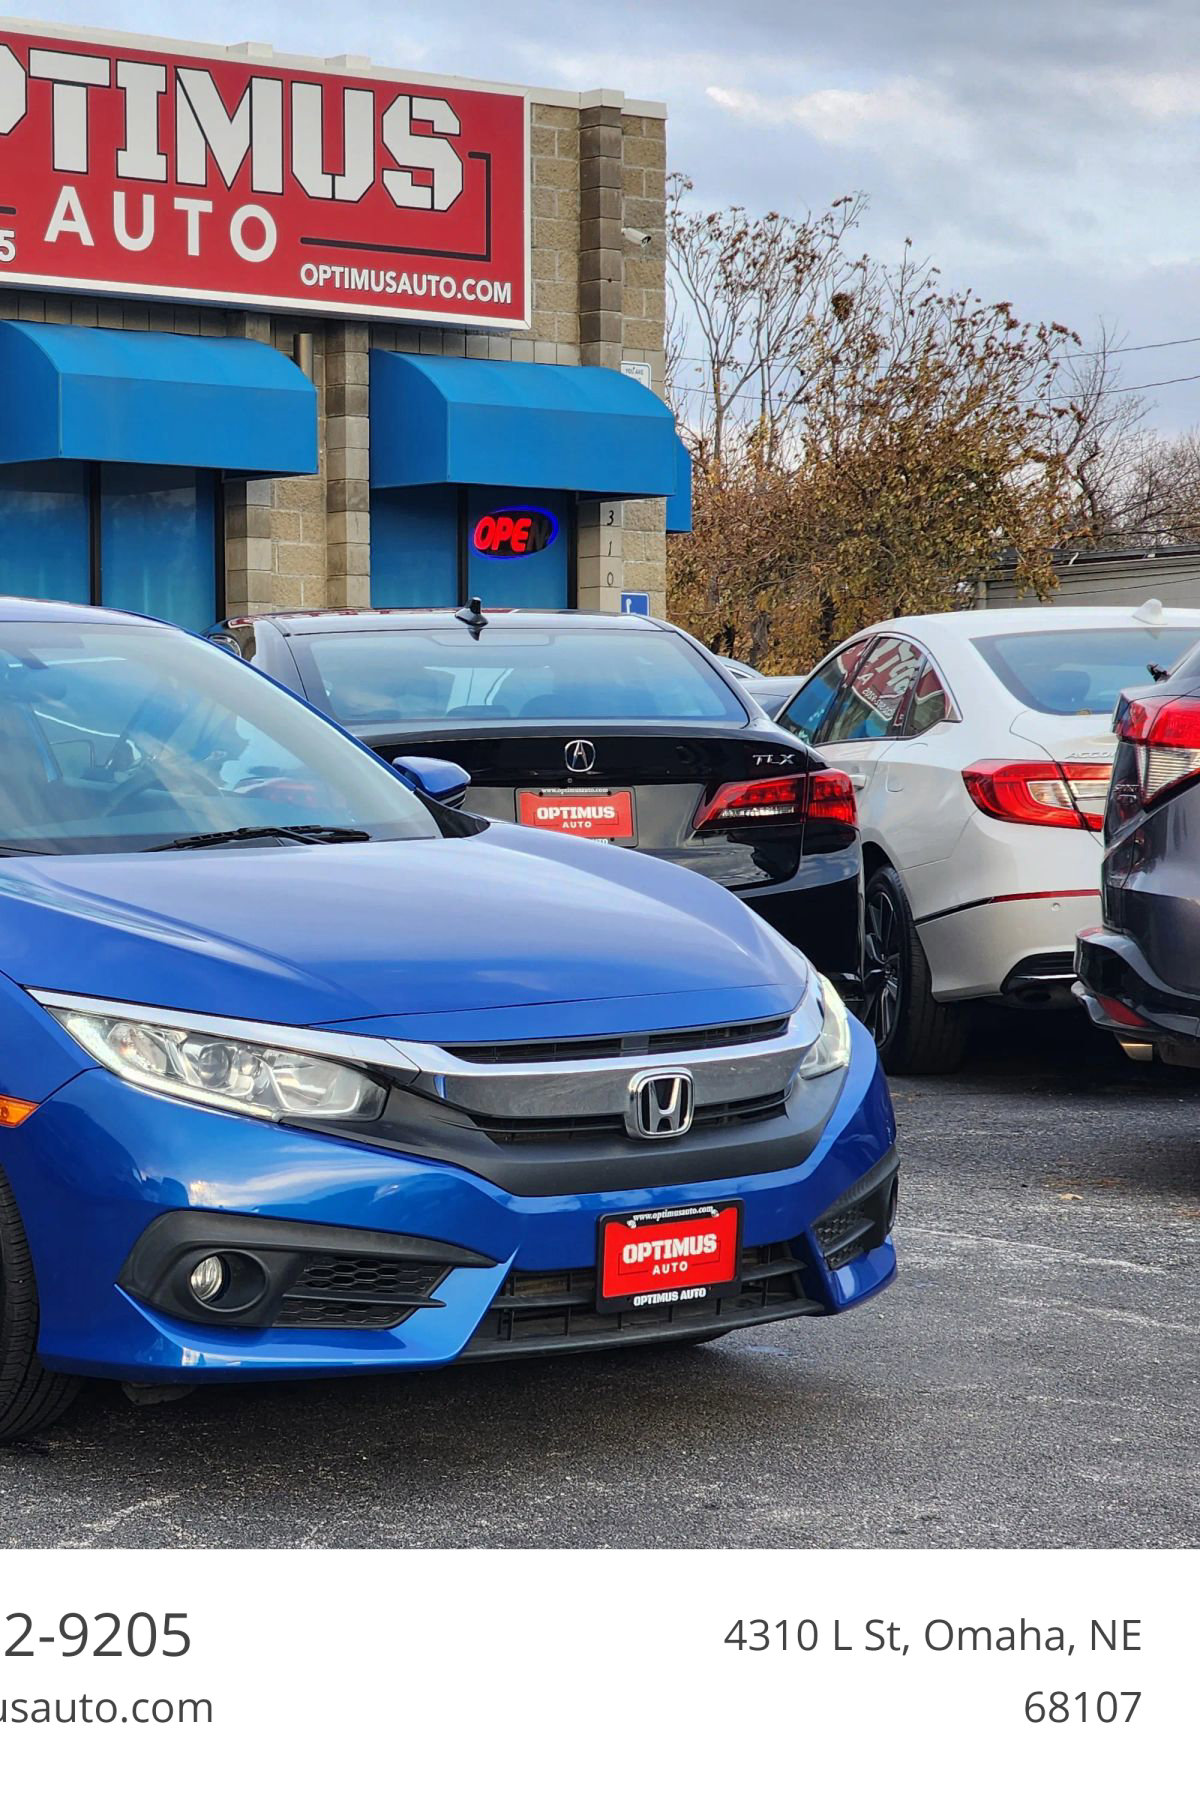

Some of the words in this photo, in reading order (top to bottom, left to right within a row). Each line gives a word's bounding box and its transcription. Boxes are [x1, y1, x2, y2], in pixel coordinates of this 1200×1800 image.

[44, 184, 278, 264] AUTO
[300, 262, 512, 304] OPTIMUSAUTO.COM
[473, 515, 550, 553] OPEN
[752, 754, 796, 766] TLX
[536, 805, 616, 820] OPTIMUS
[562, 821, 592, 829] AUTO
[633, 1205, 714, 1222] www.optimusauto.com
[622, 1233, 717, 1264] OPTIMUS
[652, 1261, 688, 1275] AUTO
[633, 1291, 679, 1306] OPTIMUS
[680, 1287, 706, 1300] AUTO
